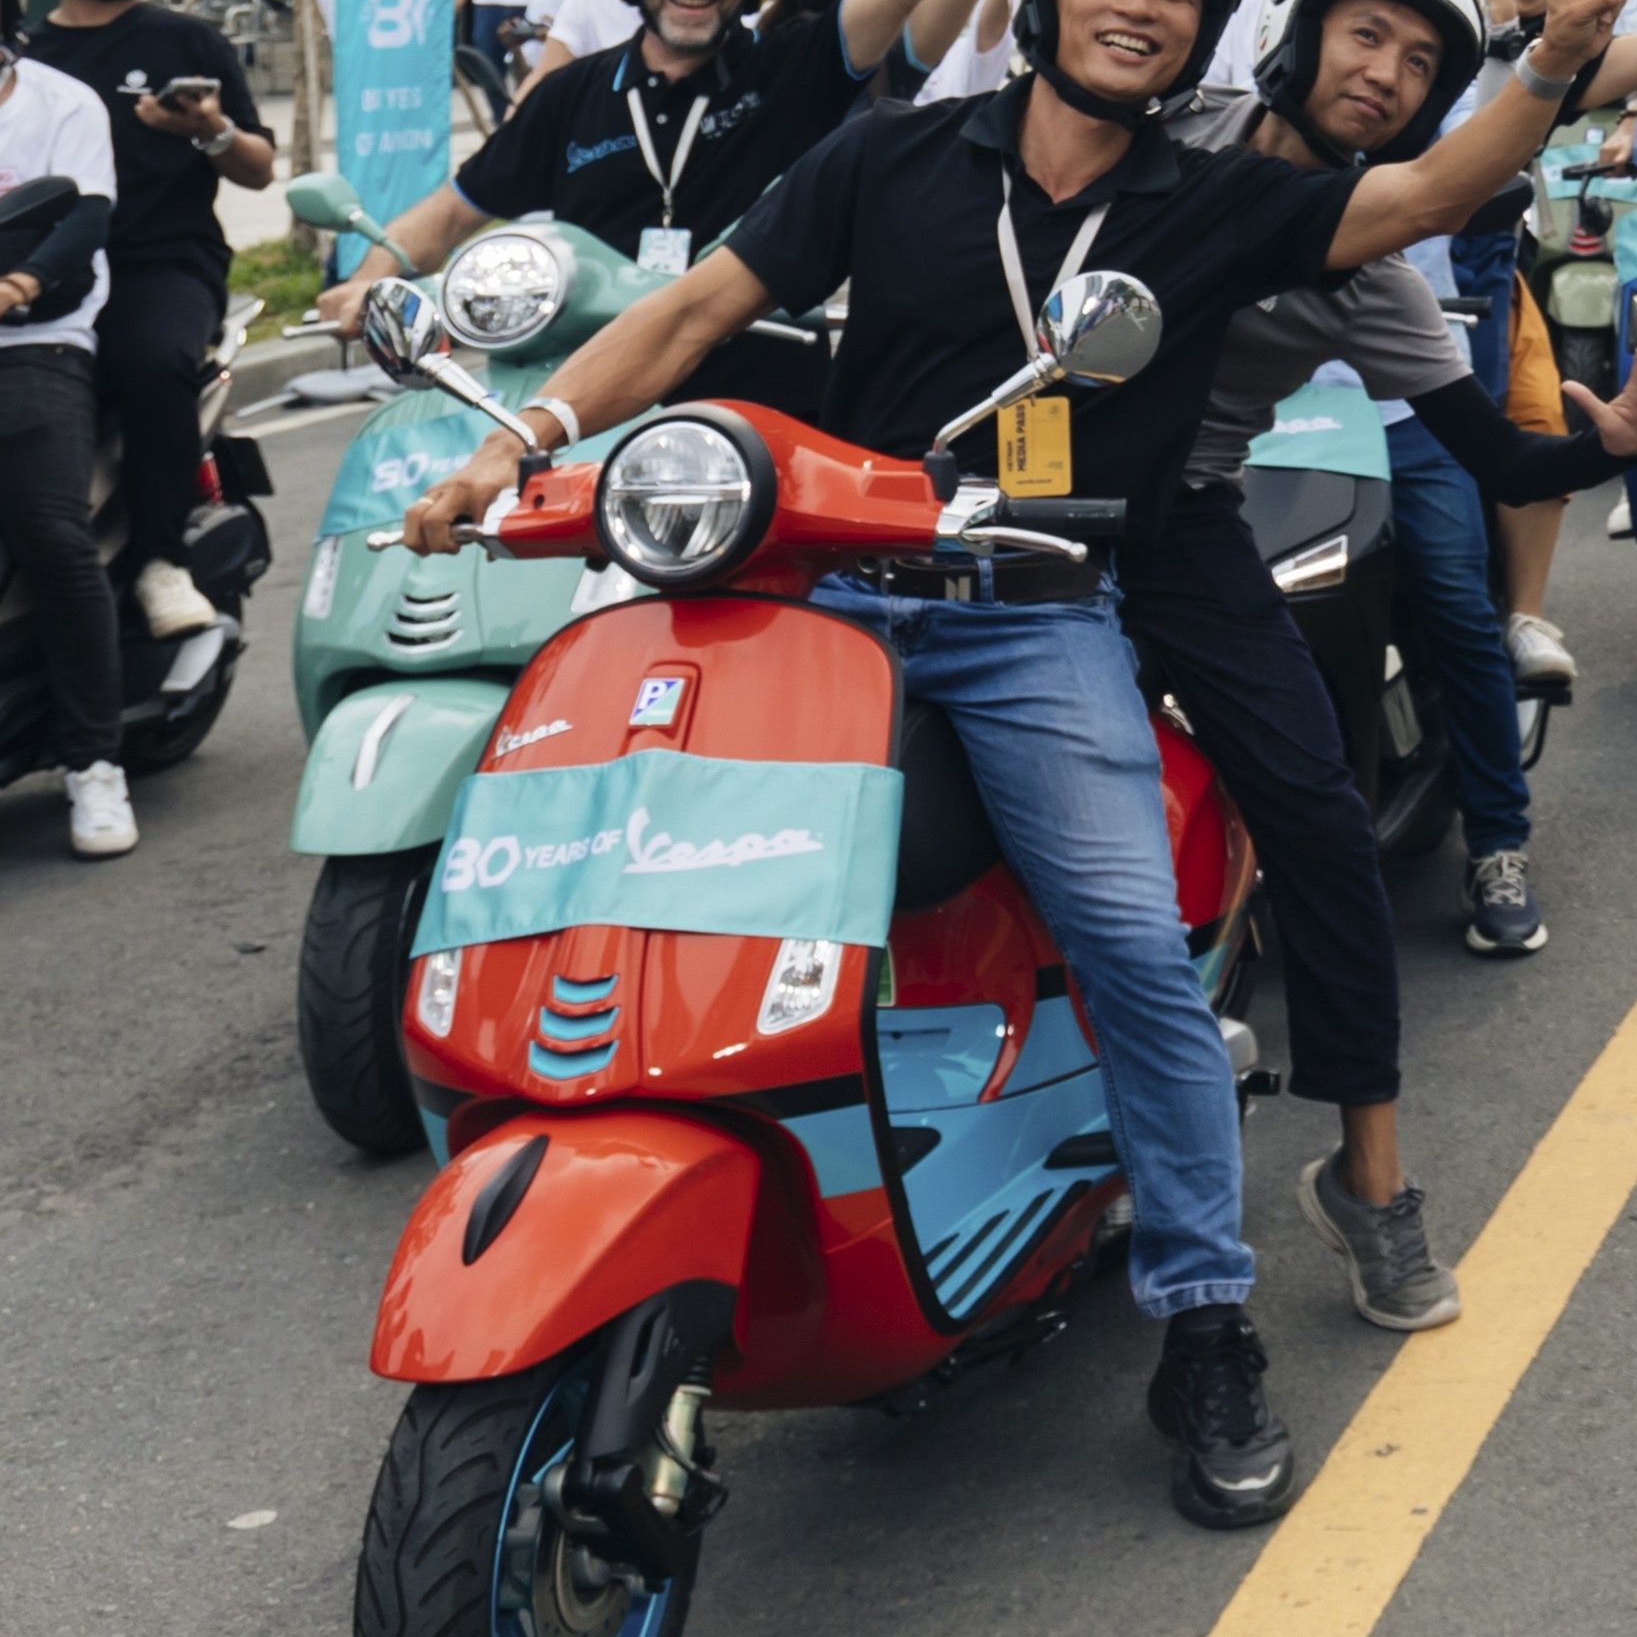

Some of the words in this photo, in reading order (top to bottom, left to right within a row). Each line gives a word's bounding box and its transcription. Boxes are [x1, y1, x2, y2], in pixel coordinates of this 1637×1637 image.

[1016, 404, 1025, 434] PASS
[1016, 436, 1026, 472] MEDIA
[494, 719, 573, 759] Vespa
[440, 834, 521, 893] 80
[524, 837, 591, 869] YEARS
[590, 828, 623, 855] OF
[621, 806, 825, 874] Vespa
